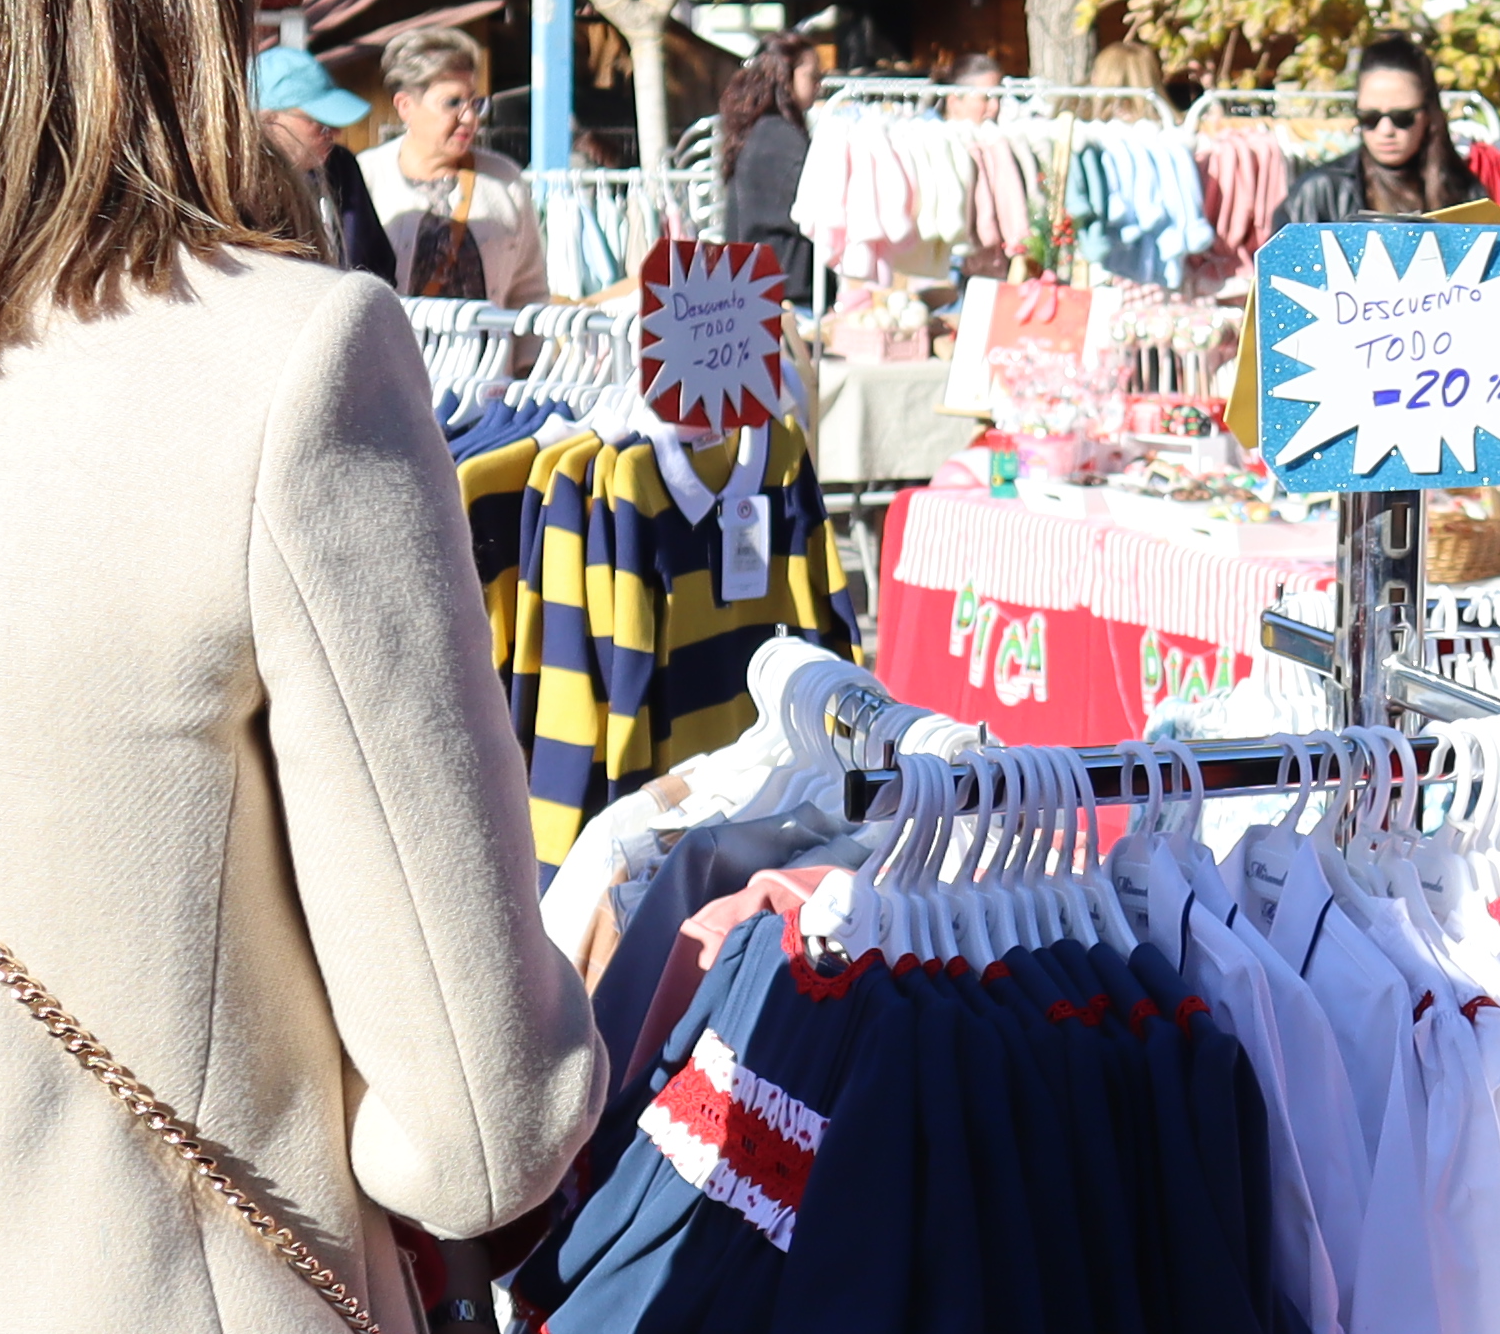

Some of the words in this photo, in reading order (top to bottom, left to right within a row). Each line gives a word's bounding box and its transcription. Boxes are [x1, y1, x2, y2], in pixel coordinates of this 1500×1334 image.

[672, 288, 746, 322] Descuento
[690, 318, 736, 342] TODO
[1356, 330, 1453, 369] TODO
[950, 576, 1046, 705] PICA
